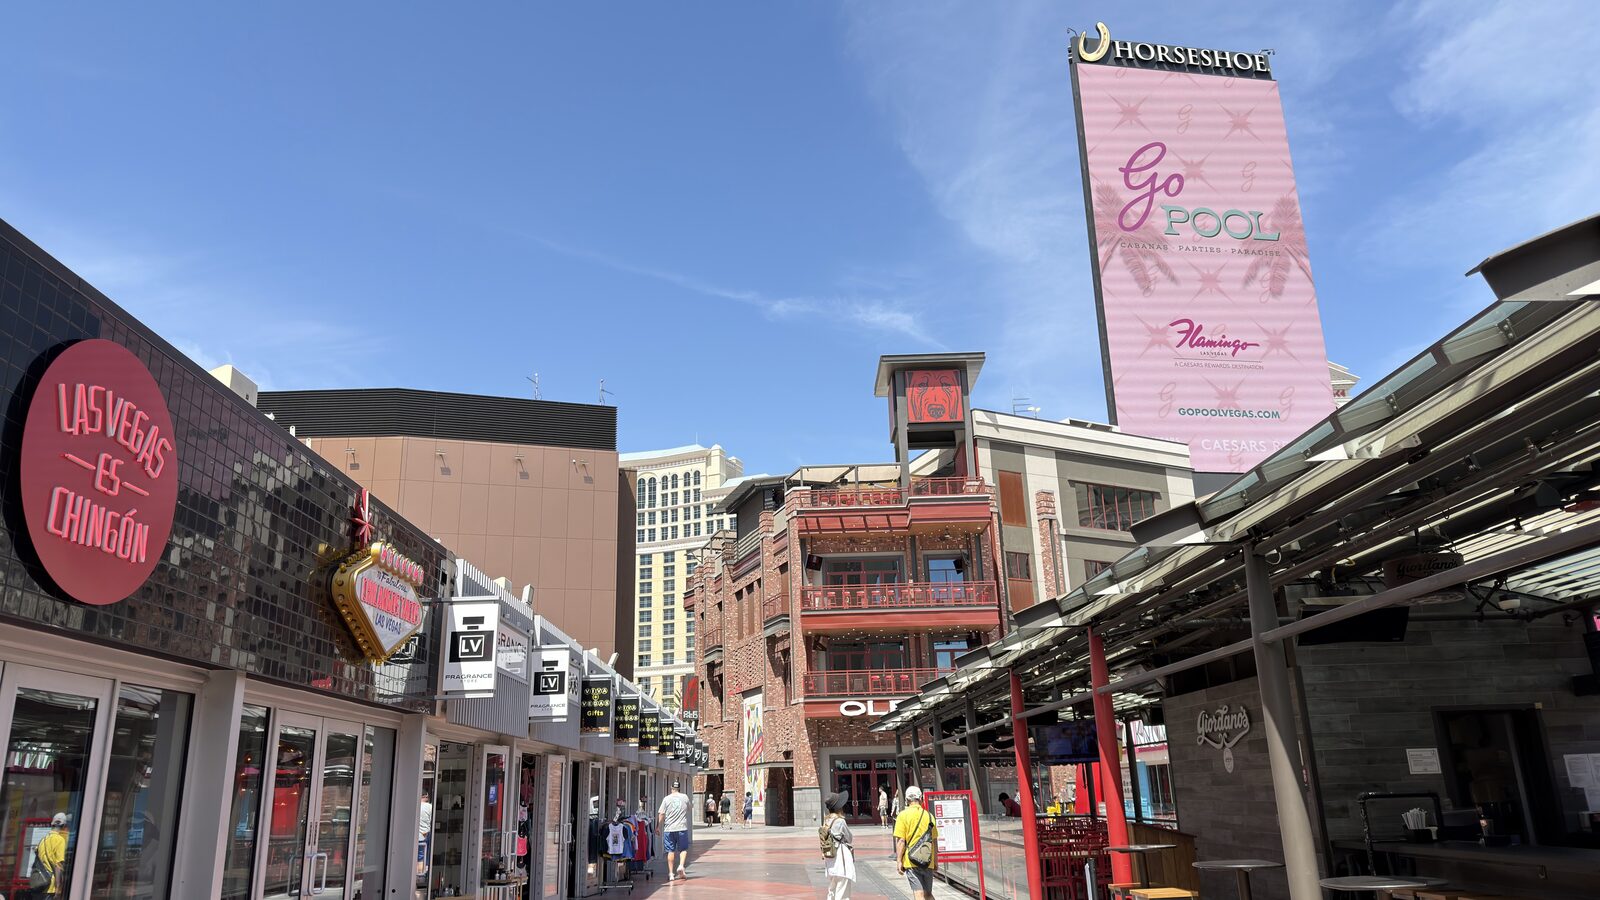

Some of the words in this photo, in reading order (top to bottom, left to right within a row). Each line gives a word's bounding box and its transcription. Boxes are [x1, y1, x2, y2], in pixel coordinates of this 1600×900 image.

[1118, 142, 1185, 232] Go
[1160, 205, 1280, 241] POOL
[1120, 242, 1169, 251] CABANAS
[1178, 245, 1221, 253] PARTIES
[1231, 248, 1281, 257] PARADISE
[1169, 318, 1260, 357] Flamingo
[58, 383, 106, 435] LAS
[106, 390, 172, 479] VEGAS
[1178, 407, 1280, 419] GOPOOLVEGAS.COM
[1201, 438, 1267, 452] CAESARS
[94, 452, 124, 496] ES
[47, 486, 149, 563] CHINGÓN
[461, 639, 482, 653] LV
[542, 677, 557, 688] LV
[1197, 705, 1250, 746] Giordano's
